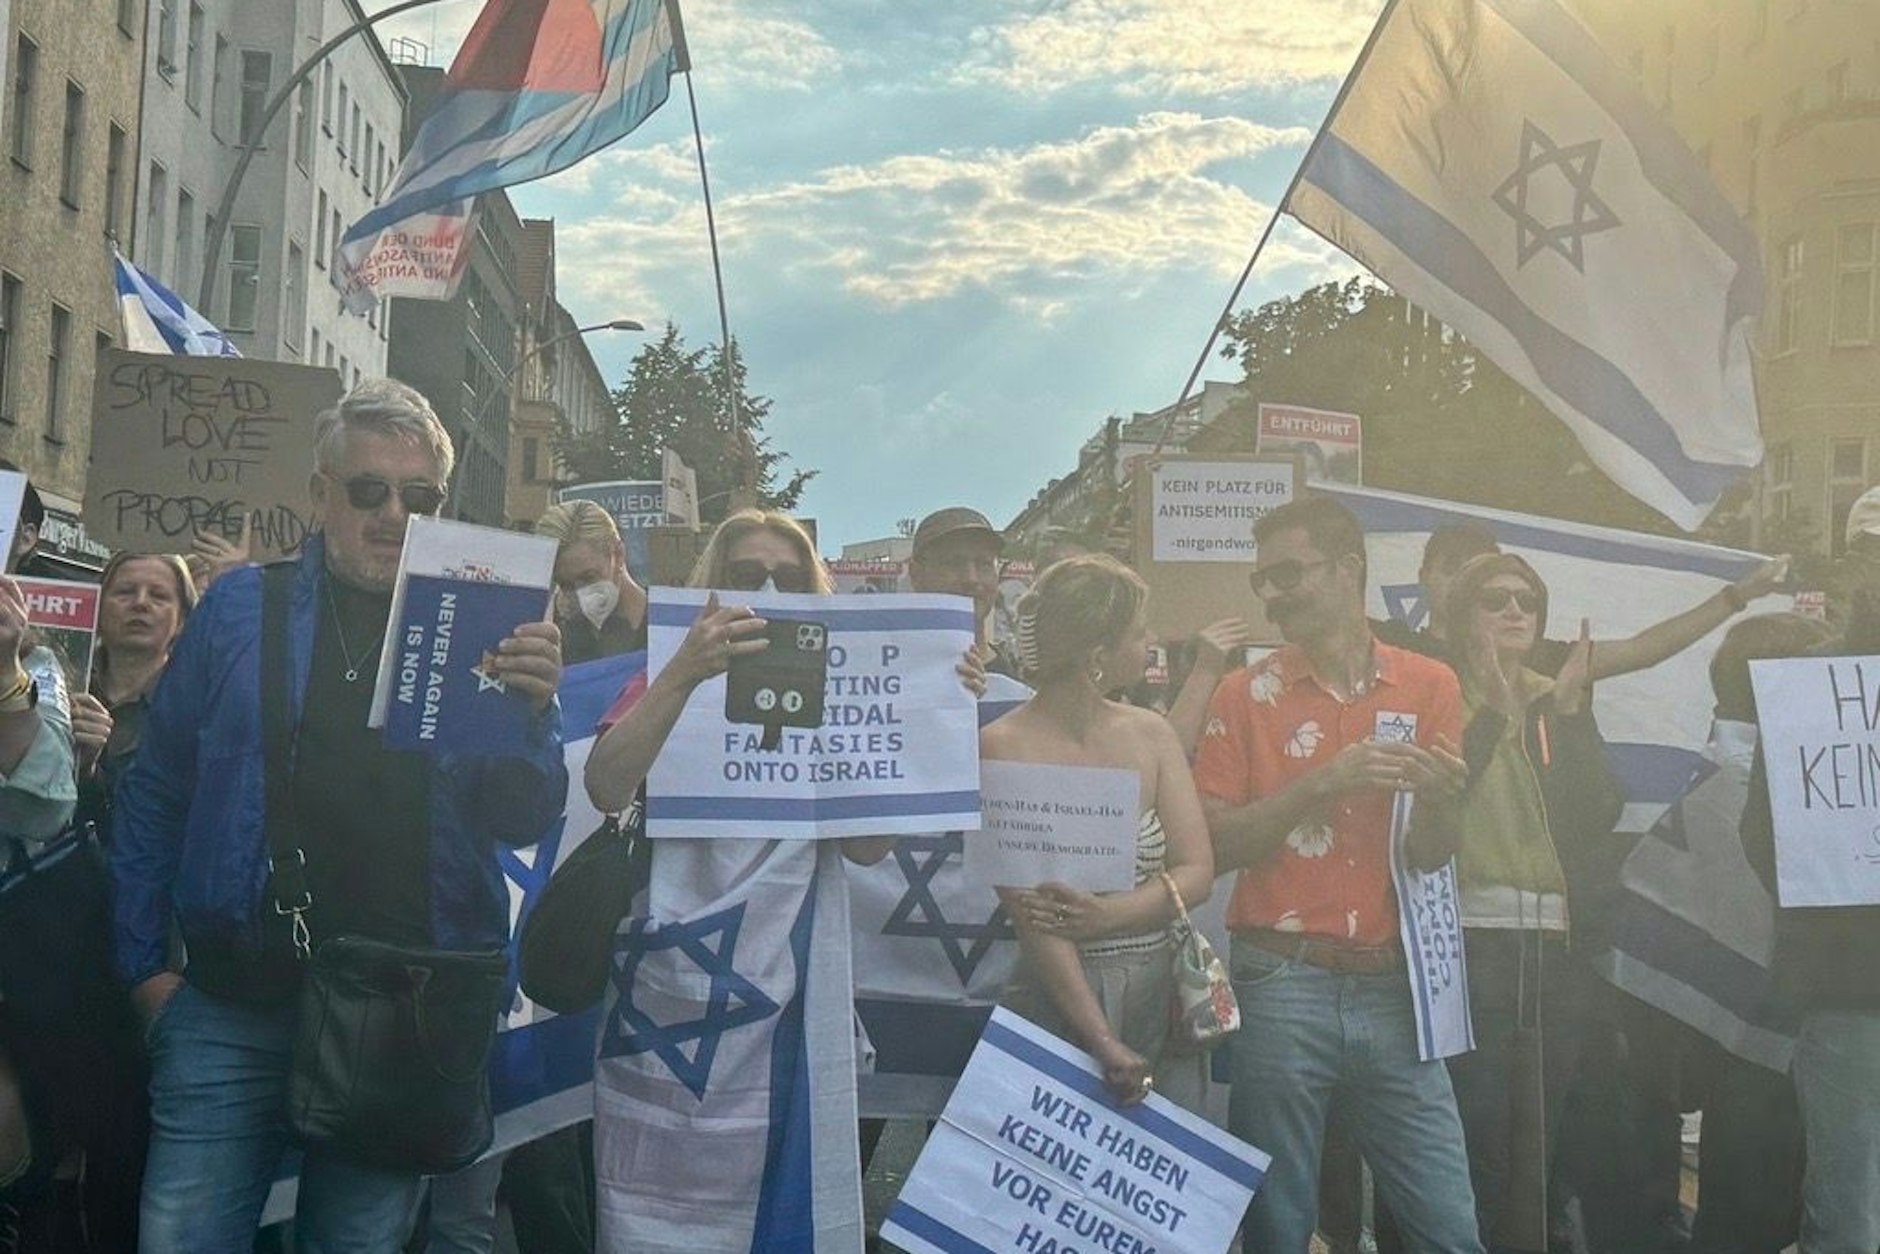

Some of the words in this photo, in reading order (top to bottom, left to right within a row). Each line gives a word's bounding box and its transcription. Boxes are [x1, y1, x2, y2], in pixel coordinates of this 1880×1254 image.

[110, 363, 271, 413] SPREAD
[162, 408, 289, 452] LOVE
[1269, 415, 1352, 437] ENTFÜHRT
[188, 457, 262, 485] NOT
[600, 494, 662, 512] WIEDE
[1161, 480, 1199, 495] KEIN
[1205, 480, 1251, 496] PLATZ
[1254, 479, 1286, 496] FÜR
[102, 489, 313, 555] PROPAGAND
[1158, 504, 1270, 520] ANTISEMITISM
[26, 593, 83, 617] HRT
[405, 625, 424, 647] IS
[430, 591, 457, 667] NEVER
[397, 652, 420, 705] NOW
[827, 674, 901, 697] TING
[418, 671, 444, 740] AGAIN
[827, 703, 902, 727] IDAL
[723, 761, 800, 783] ONTO
[807, 760, 905, 783] ISRAEL
[1438, 870, 1459, 960] HOM
[1030, 1084, 1093, 1140] WIR
[1095, 1124, 1189, 1193] HABEN
[991, 1159, 1054, 1216] VOR
[997, 1114, 1092, 1182] KEINE
[1091, 1169, 1188, 1233] ANGST
[1014, 1222, 1082, 1254] HA
